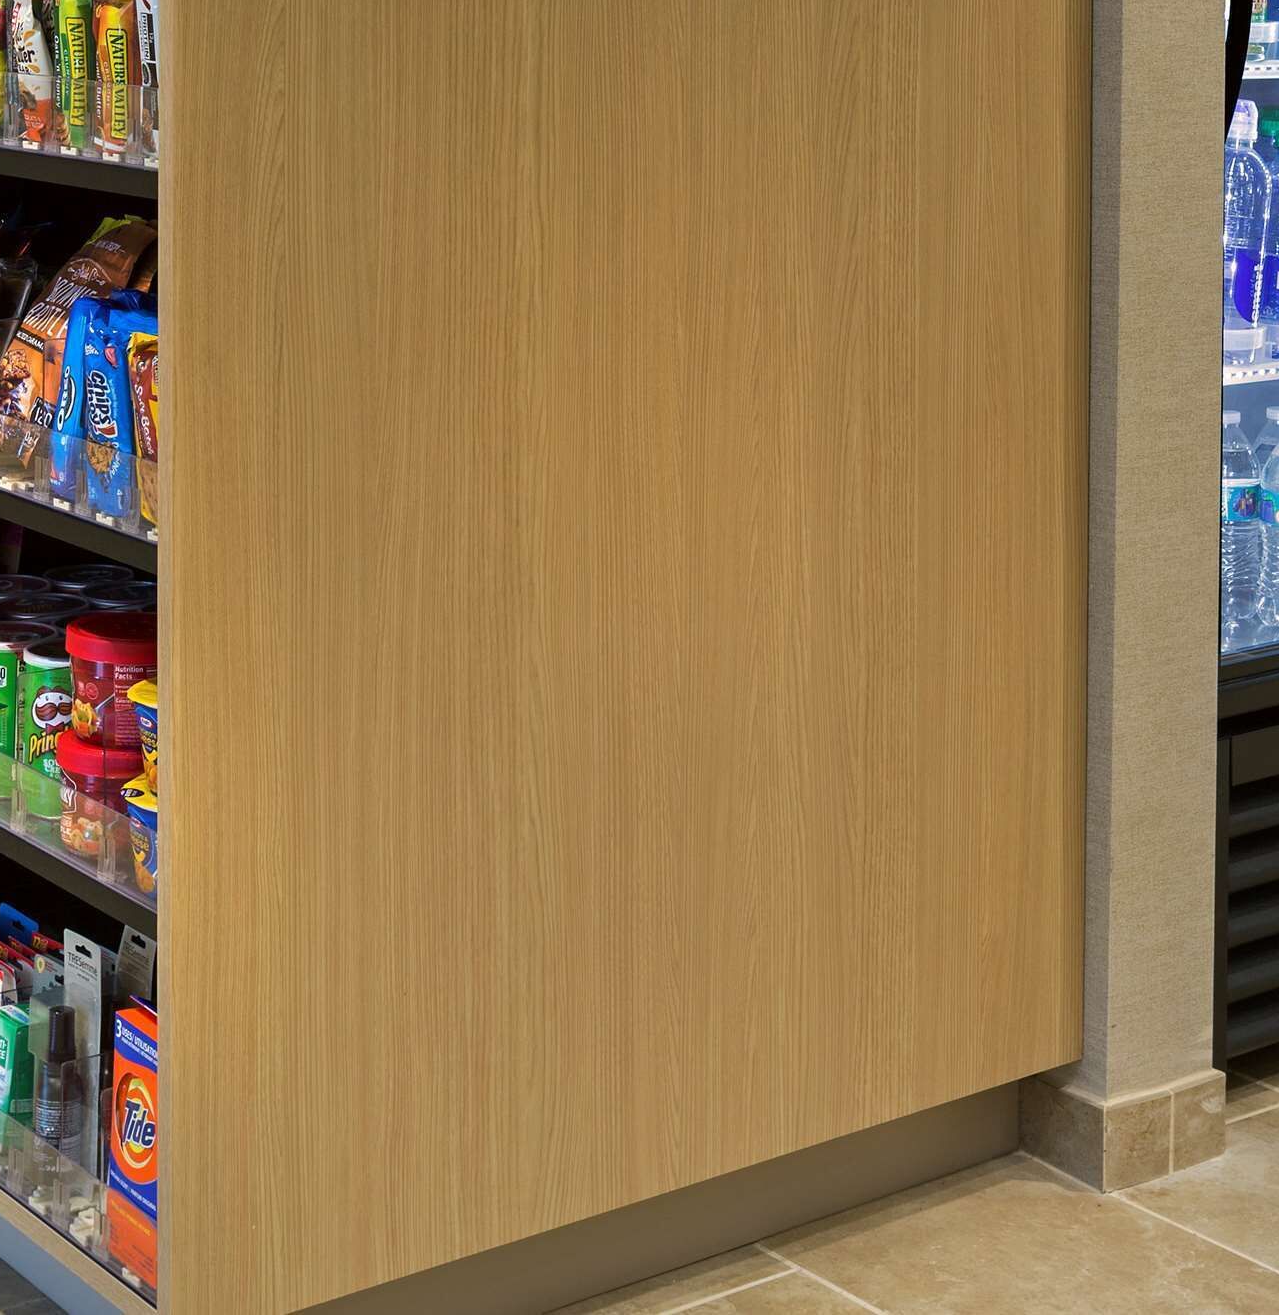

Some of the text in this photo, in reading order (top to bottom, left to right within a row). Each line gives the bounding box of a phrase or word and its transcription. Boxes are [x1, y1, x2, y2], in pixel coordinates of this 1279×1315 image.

[68, 22, 86, 124] NATURE VALLEY
[109, 33, 127, 137] NATURE VALLEY
[56, 365, 71, 432] OREO
[114, 665, 144, 674] Nutrition
[114, 673, 133, 681] Facts
[115, 1018, 122, 1038] 3
[122, 1099, 157, 1150] Tide
